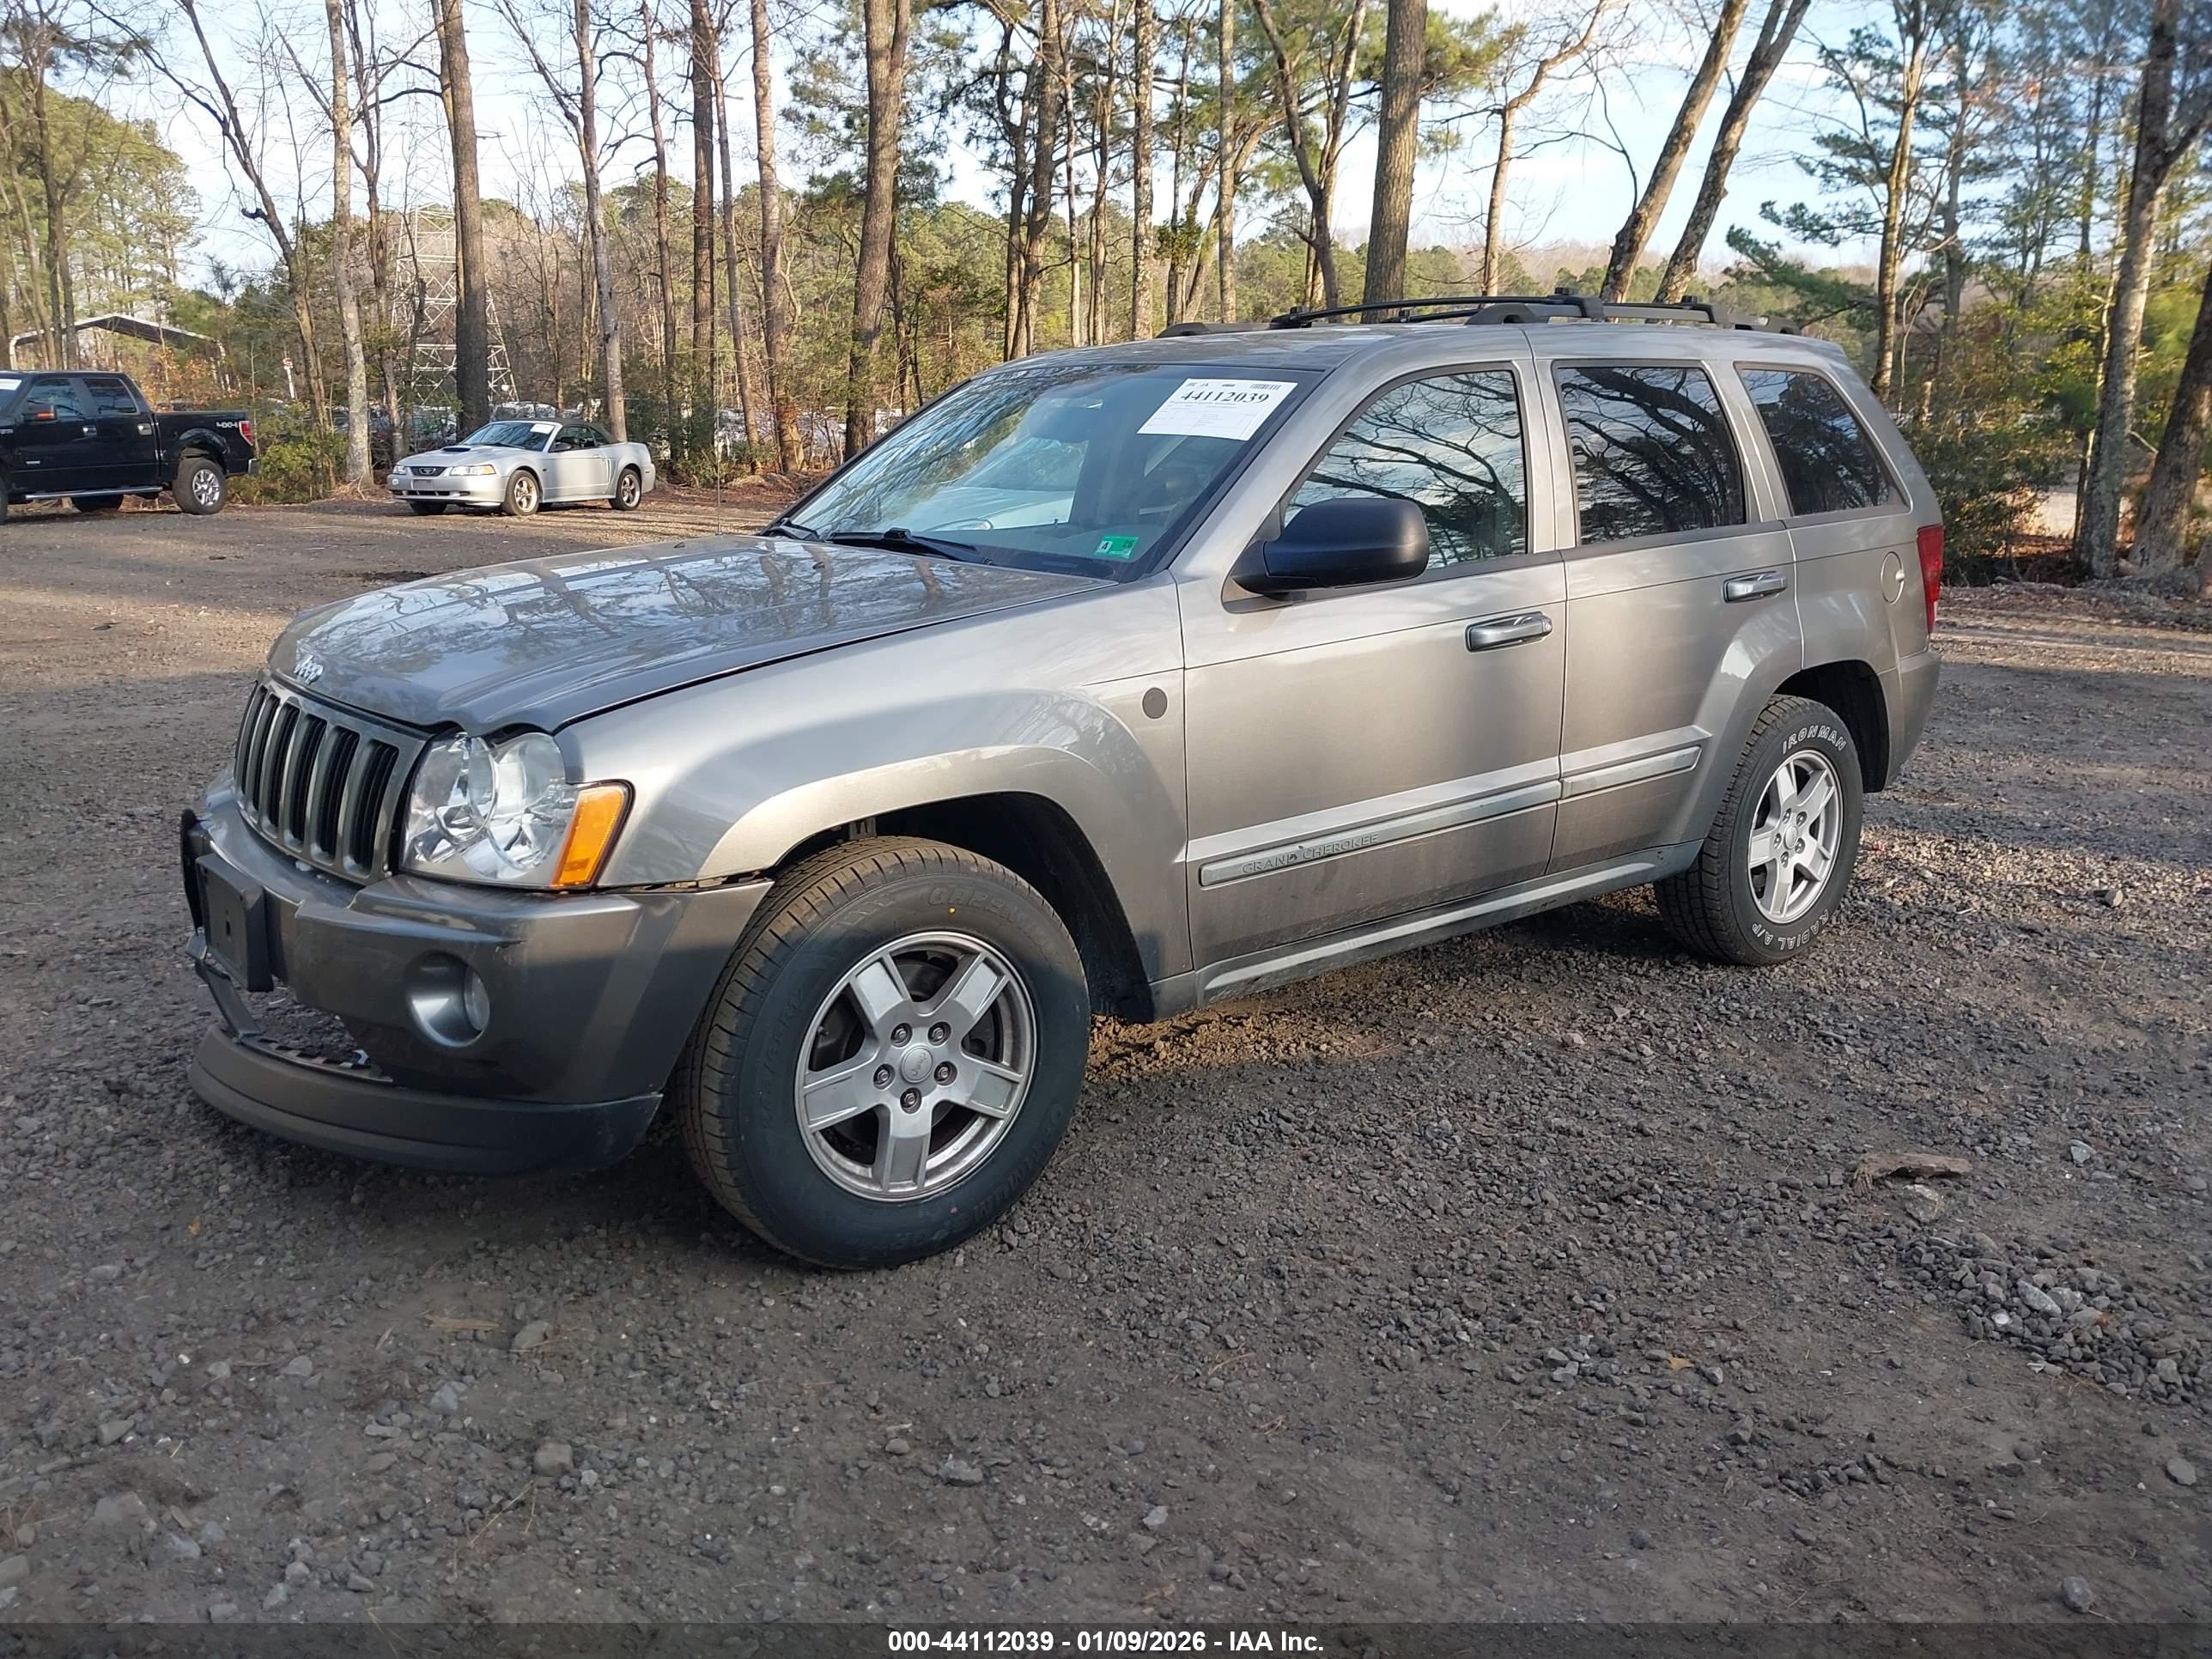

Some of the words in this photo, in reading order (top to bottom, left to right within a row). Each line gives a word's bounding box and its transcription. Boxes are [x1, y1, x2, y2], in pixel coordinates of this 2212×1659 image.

[1181, 391, 1269, 403] 44112039
[1782, 725, 1847, 755] IRONMAN
[1243, 851, 1298, 874] GRAND
[1303, 833, 1378, 860] CHEROKEE
[1778, 908, 1830, 951] RADIAL
